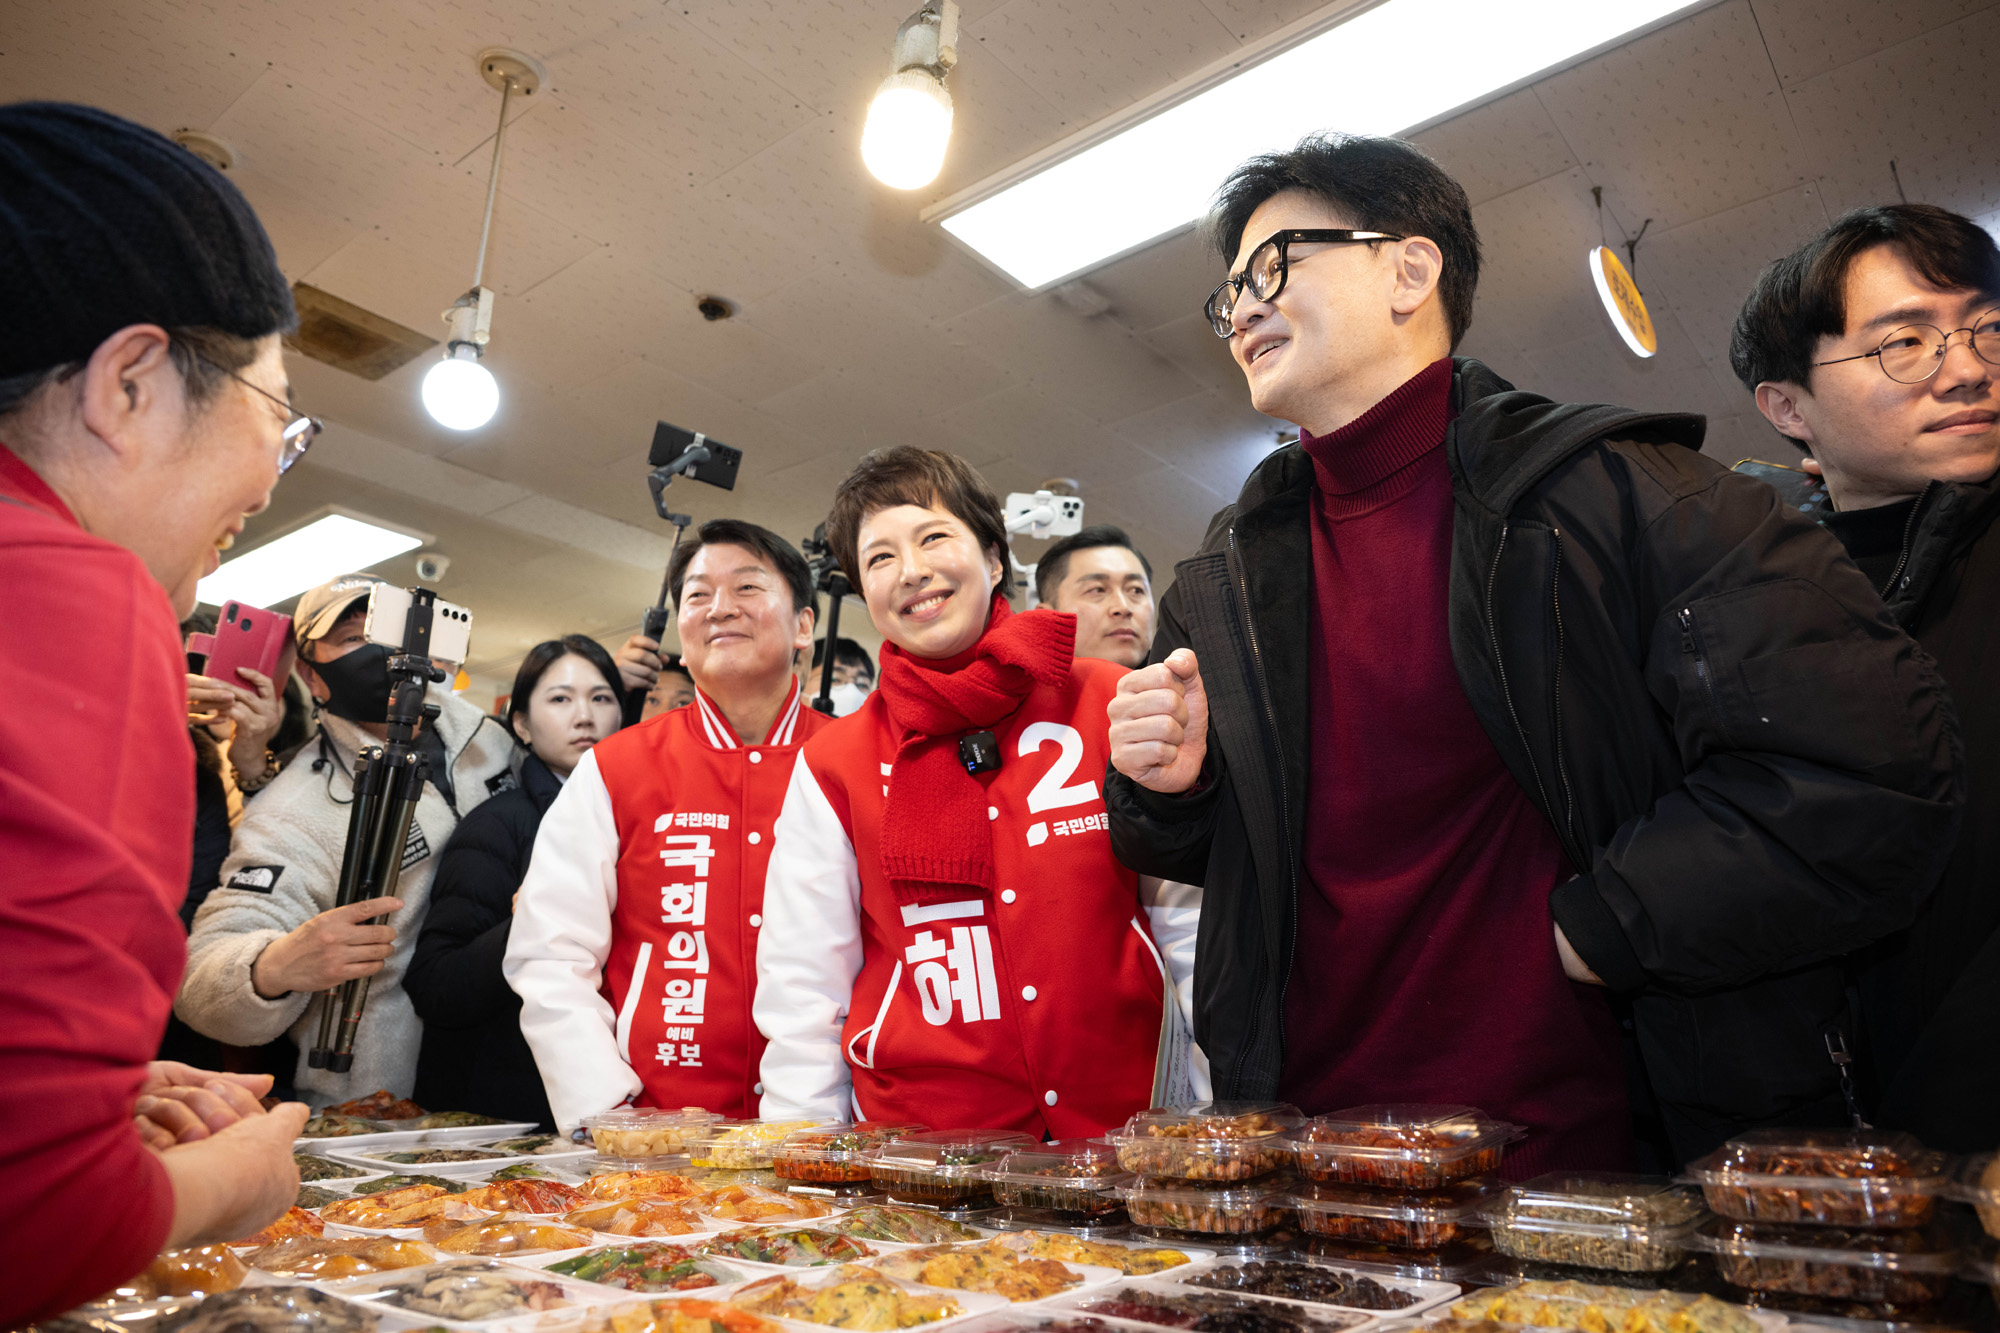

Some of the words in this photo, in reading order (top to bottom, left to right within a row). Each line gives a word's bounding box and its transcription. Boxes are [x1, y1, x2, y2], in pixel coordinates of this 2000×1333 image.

[1018, 722, 1100, 814] 2
[675, 812, 730, 830] 국민의힘
[660, 834, 716, 1024] 국회의원
[666, 1026, 694, 1042] 예비
[655, 1042, 703, 1067] 후보
